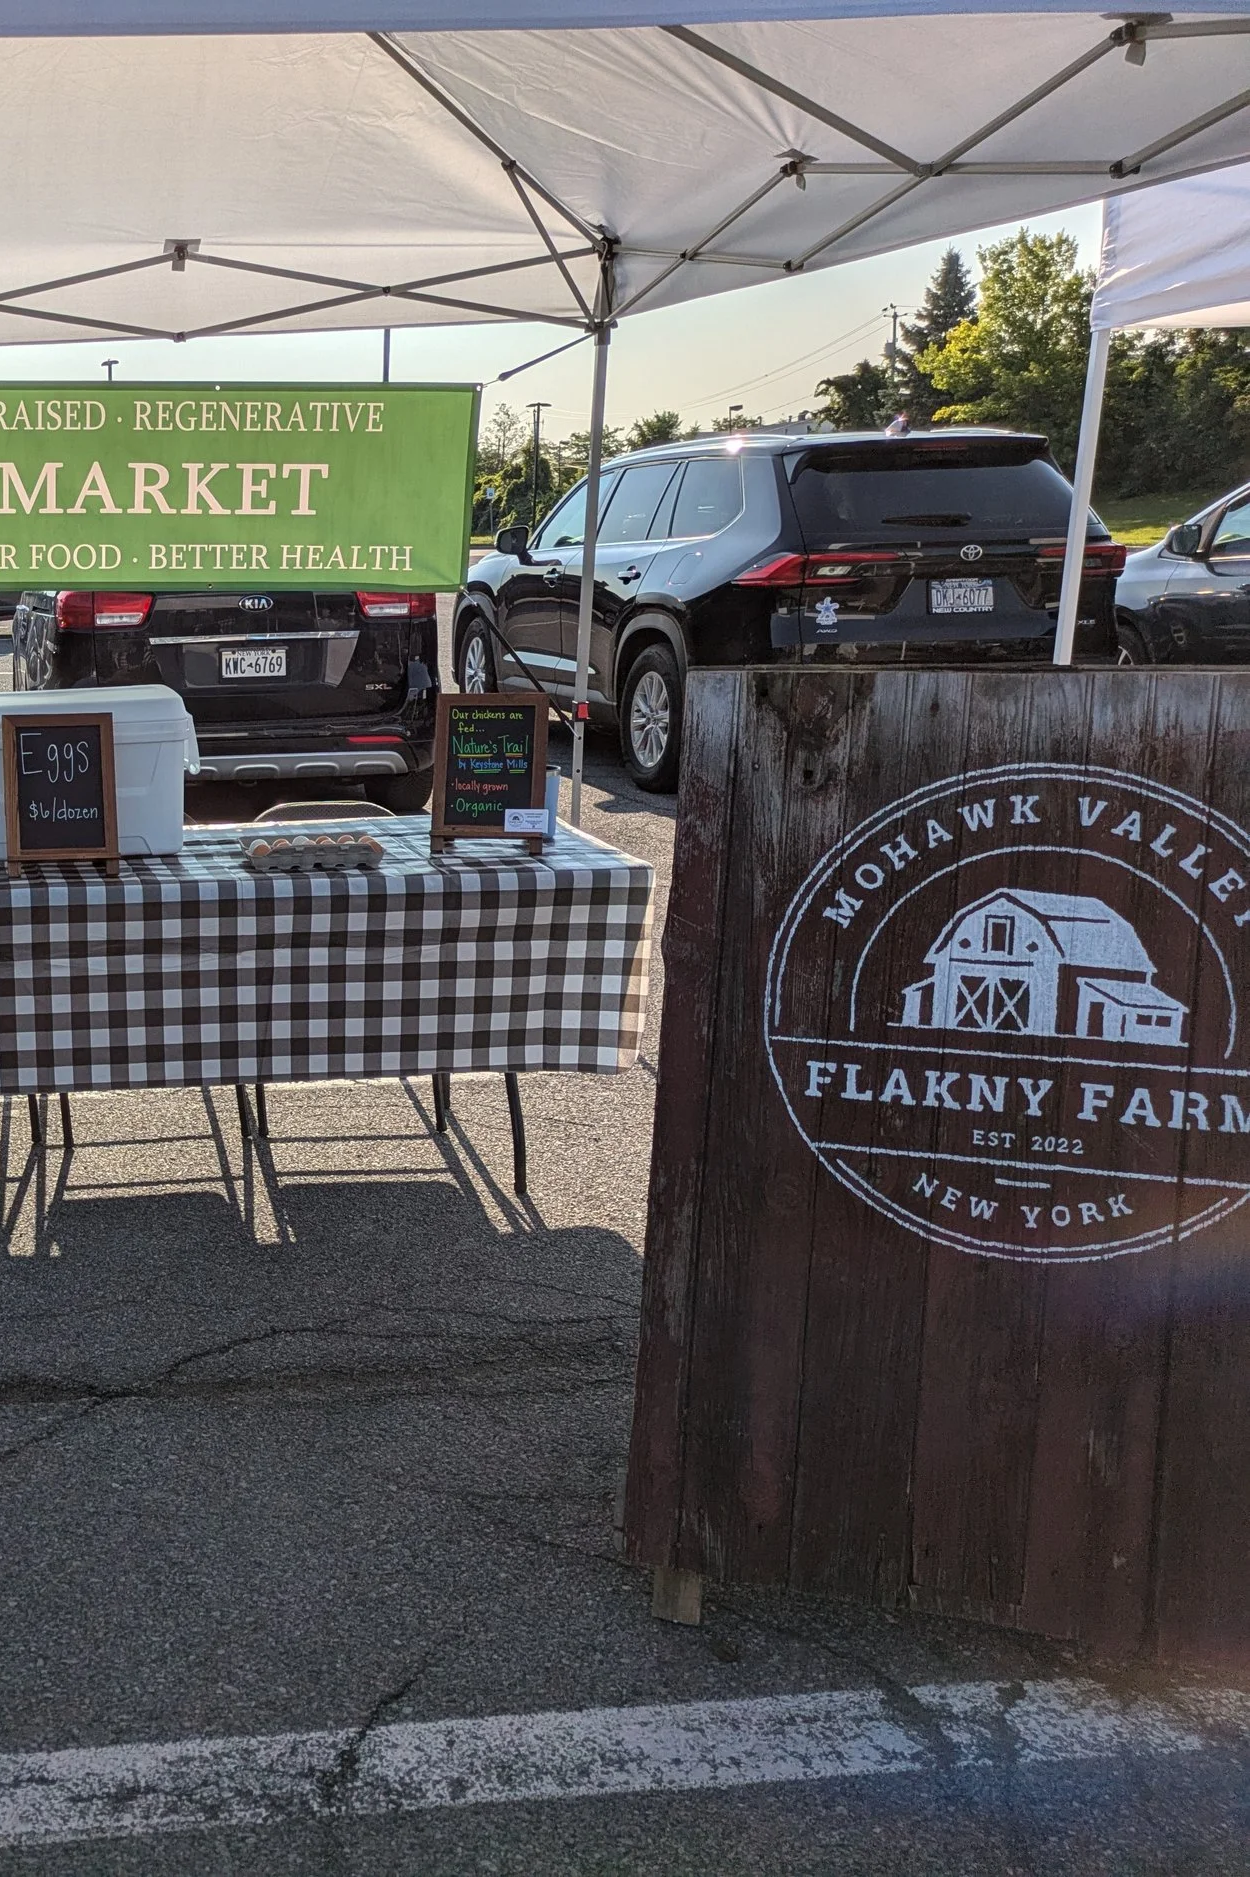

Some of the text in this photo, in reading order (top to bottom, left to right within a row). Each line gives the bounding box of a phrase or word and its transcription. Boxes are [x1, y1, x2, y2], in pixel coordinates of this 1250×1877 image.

[133, 400, 385, 433] REGENERATIVE
[29, 544, 122, 571] FOOD
[148, 544, 271, 571] BETTER
[280, 544, 414, 572] HEALTH
[244, 598, 268, 609] KIA
[365, 683, 392, 691] SXL
[452, 709, 469, 720] Our
[472, 710, 506, 720] chickens
[20, 732, 89, 783] Eggs
[452, 734, 530, 755] Nature's Trail
[458, 758, 528, 769] by Keystone Mills
[455, 778, 510, 795] locally grown
[29, 797, 99, 823] $6/dozen
[456, 798, 504, 818] Organic
[823, 794, 1041, 930] MOHAWK
[804, 1060, 1054, 1118] FLAKNY
[972, 1129, 1085, 1156] EST 2022
[911, 1172, 1134, 1230] NEW YORK
